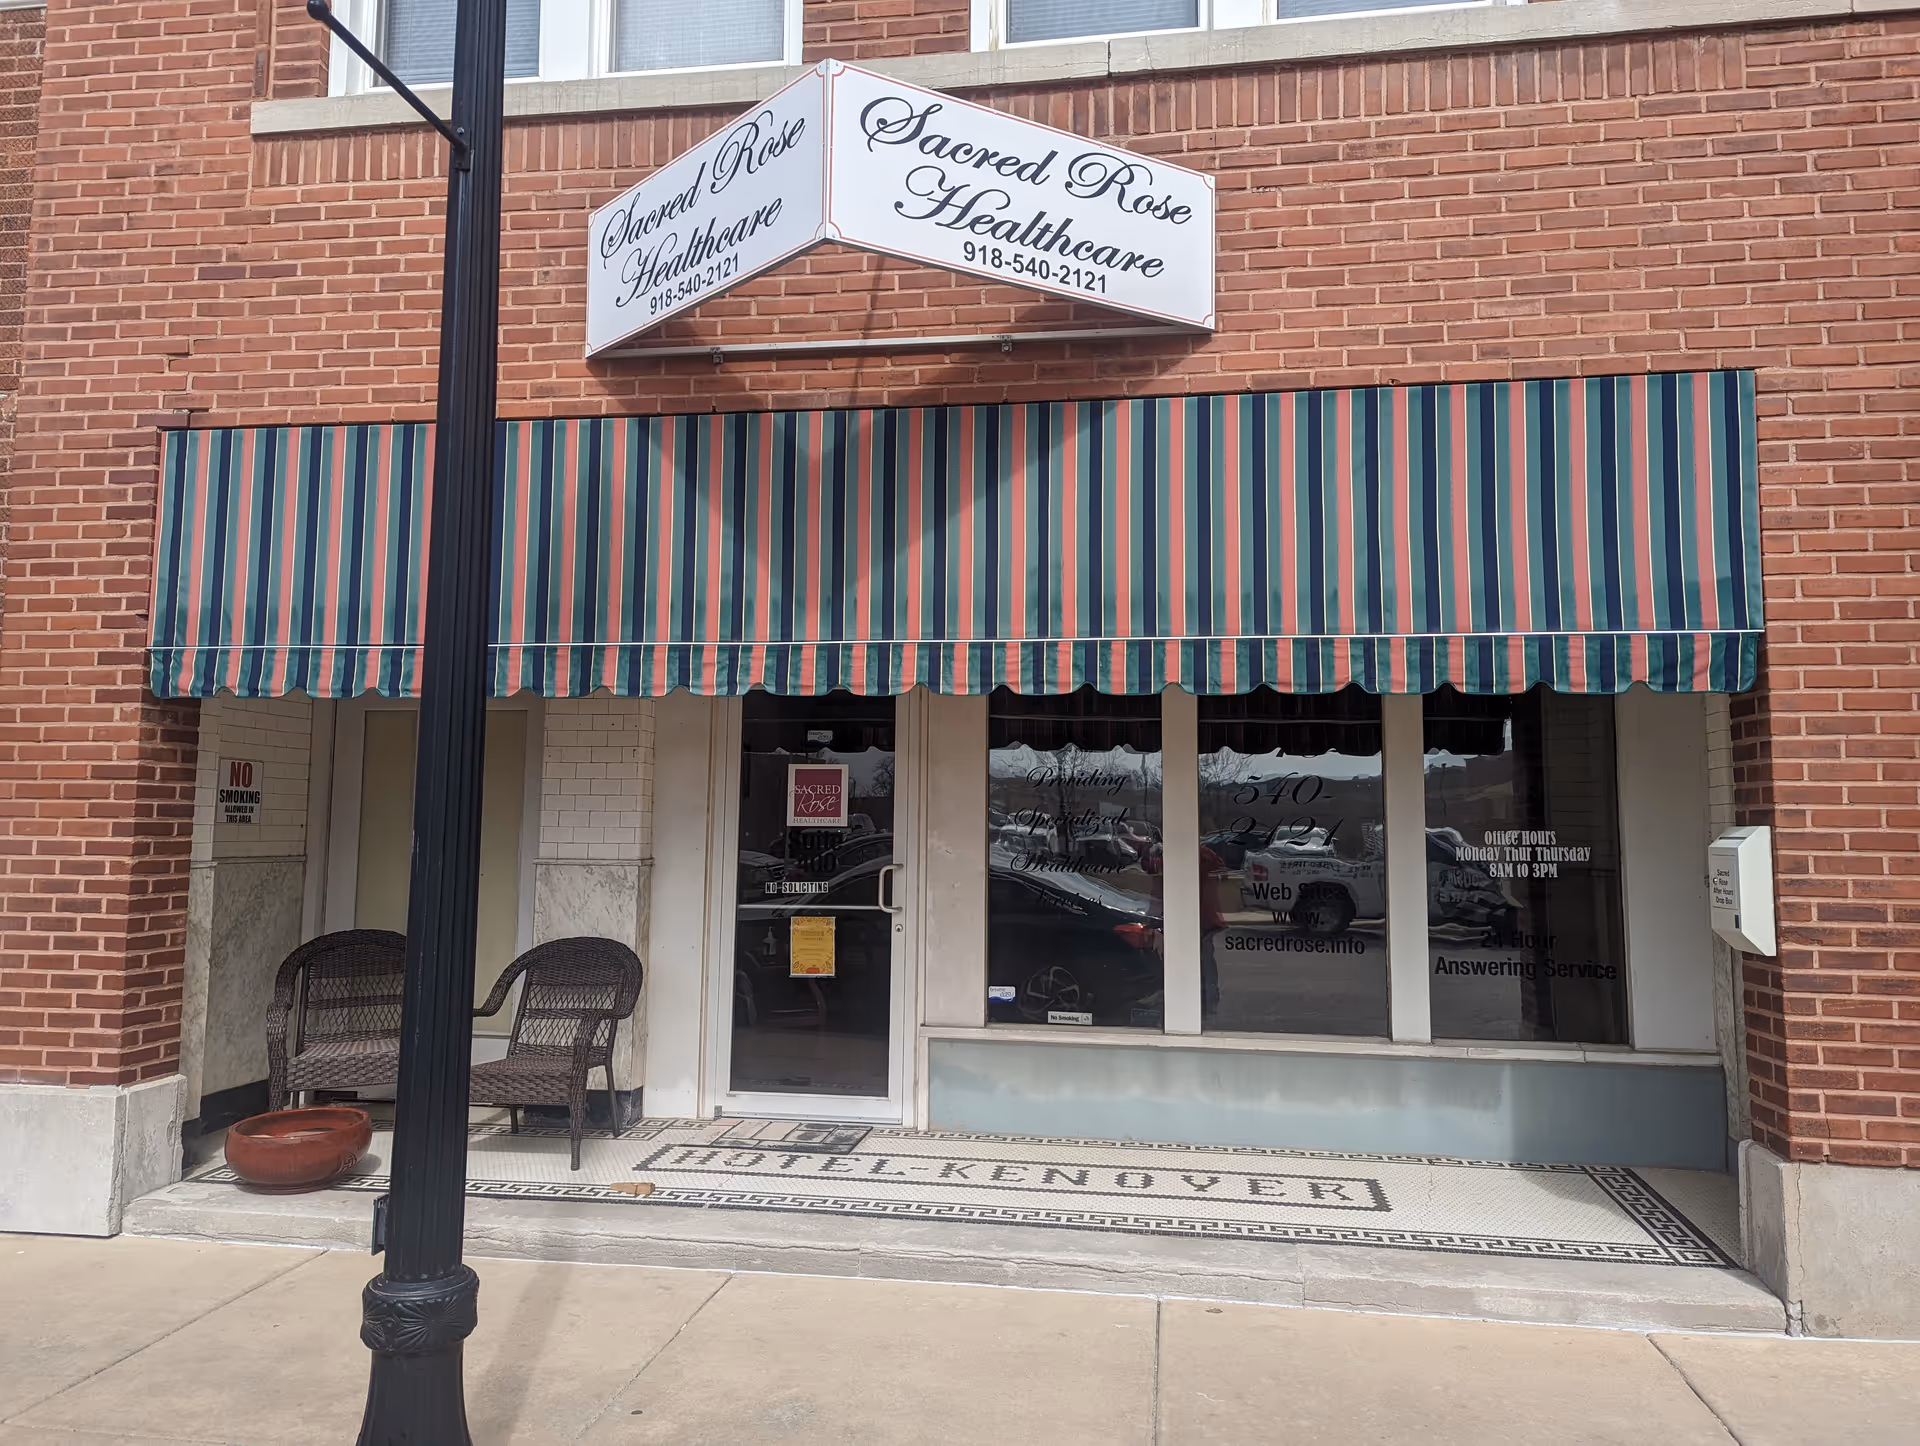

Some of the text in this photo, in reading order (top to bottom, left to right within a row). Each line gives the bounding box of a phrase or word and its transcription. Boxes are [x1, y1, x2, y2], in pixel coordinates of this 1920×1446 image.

[860, 97, 1192, 224] Sacred Rose
[601, 110, 806, 269] Sacred Rose
[894, 165, 1164, 277] Healthcare
[616, 198, 783, 307] Healthcare
[963, 241, 1107, 293] 918-540-2121
[650, 252, 738, 315] 918-540-2121
[229, 761, 253, 788] NO
[1026, 766, 1128, 796] Providing
[219, 789, 260, 804] SMOKING
[790, 787, 840, 814] Rose
[793, 784, 841, 794] SACRED
[1233, 772, 1337, 806] 540-
[224, 805, 247, 813] ALLOWED
[226, 815, 251, 823] THIS AREA
[1014, 806, 1129, 836] Specialized
[1227, 815, 1345, 847] 2121
[1484, 831, 1557, 846] Office Hours
[1010, 849, 1126, 875] Healthcare
[1455, 847, 1592, 863] Monday Thur Thursday
[1489, 863, 1559, 878] 8AM to 3PM
[1716, 869, 1730, 877] Sacred
[765, 882, 828, 893] NO SOLICITING
[1252, 882, 1292, 901] Web
[1225, 935, 1366, 955] sacredrose.info
[1511, 930, 1556, 949] Hour
[1434, 956, 1617, 980] Answering Service
[1050, 1013, 1080, 1023] No Smoking
